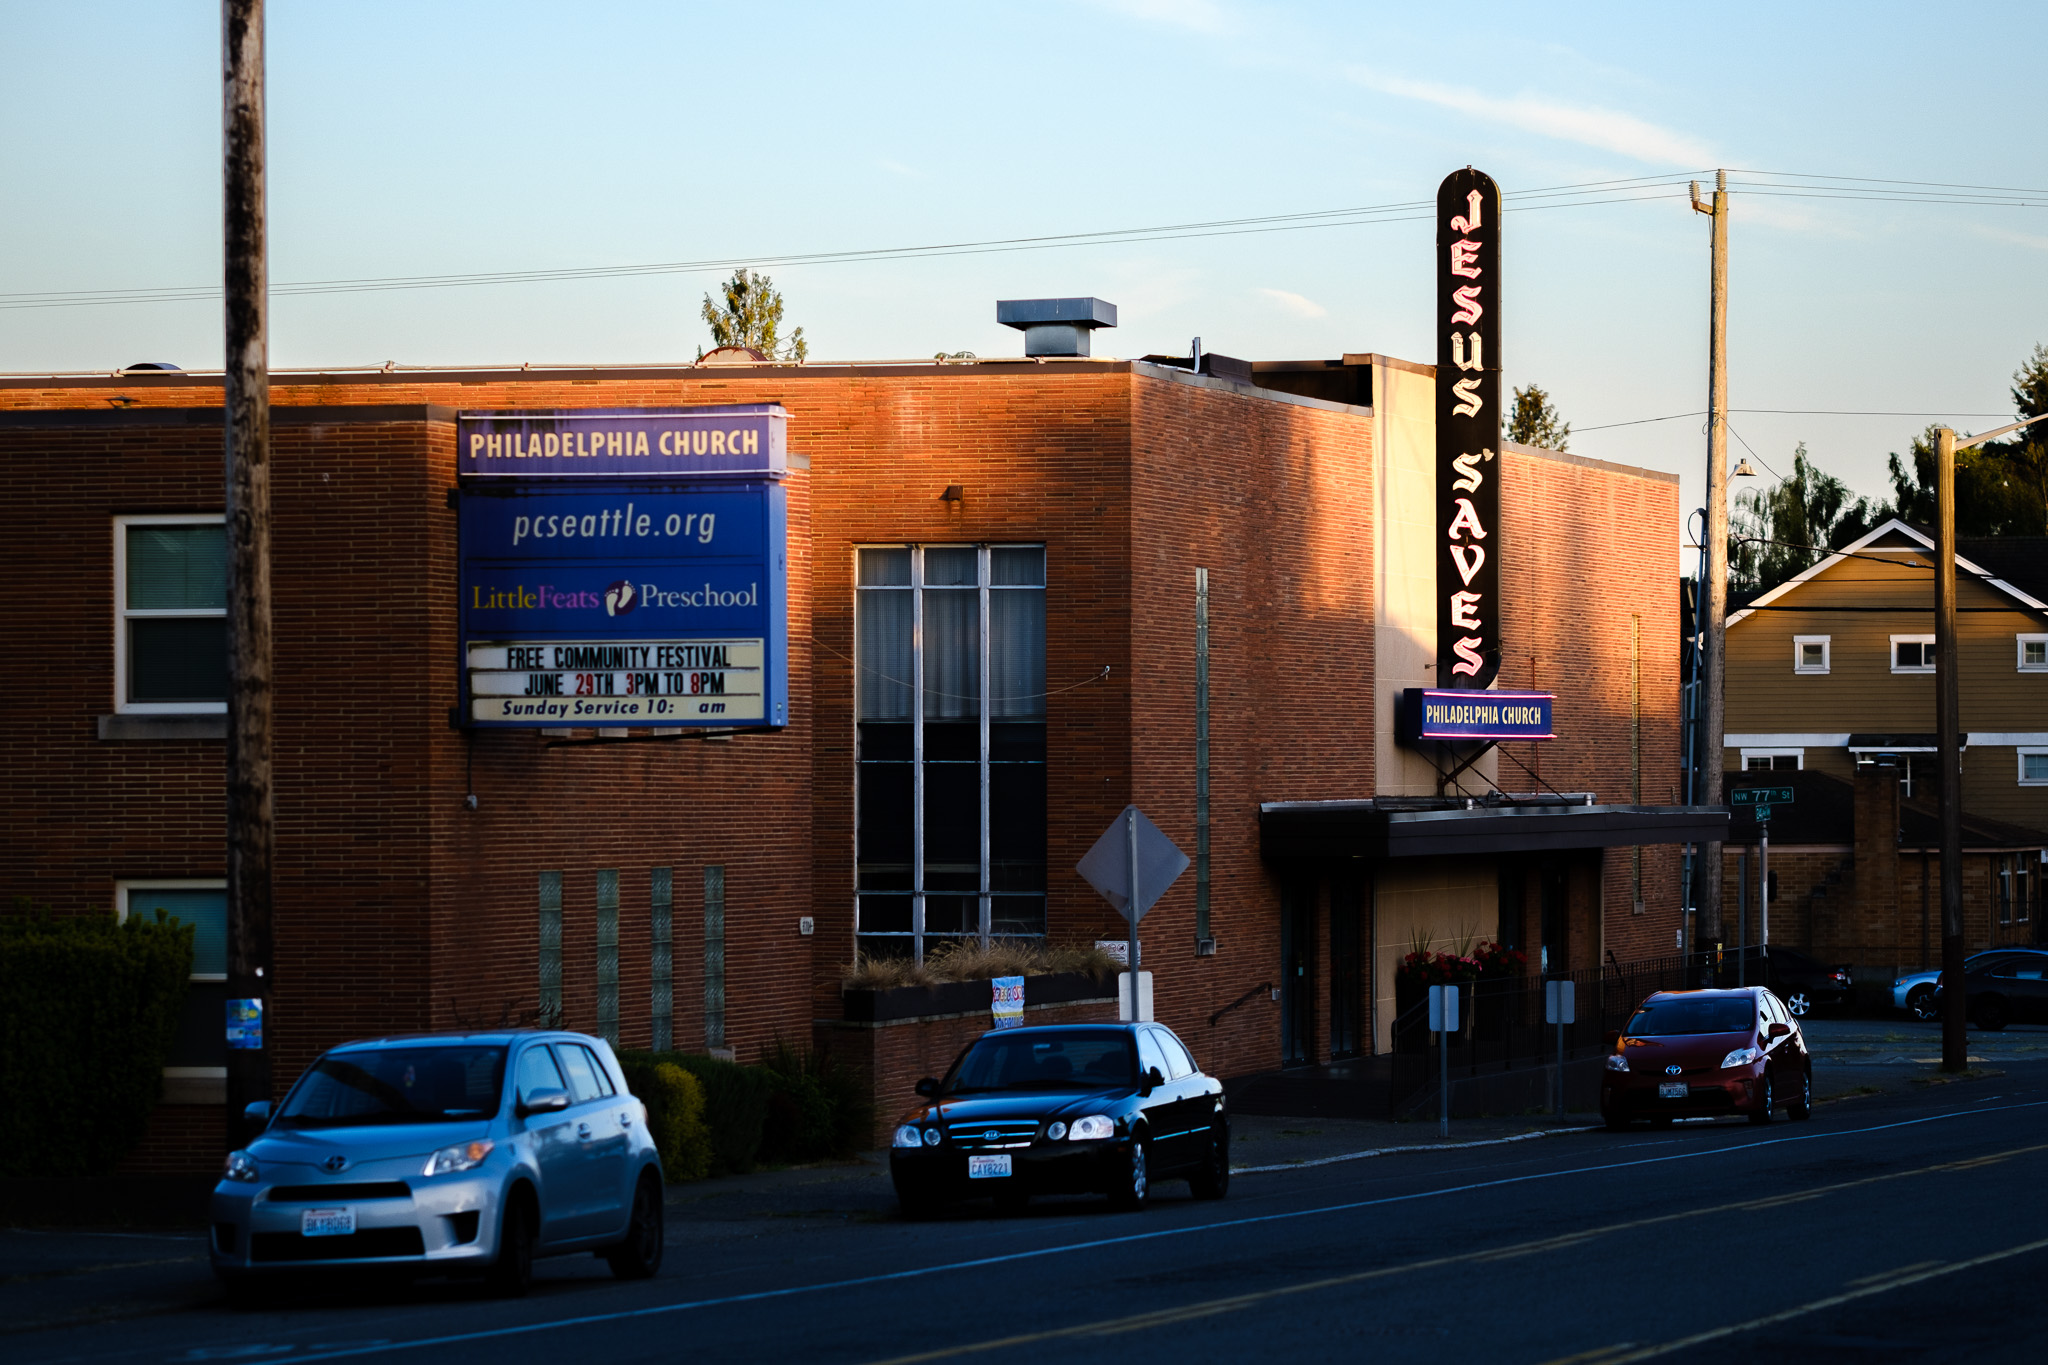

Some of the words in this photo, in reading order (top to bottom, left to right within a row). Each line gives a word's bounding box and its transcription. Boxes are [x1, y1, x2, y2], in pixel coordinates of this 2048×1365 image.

[1450, 189, 1484, 418] JESUS
[470, 430, 650, 458] PHILADELPHIA
[658, 429, 760, 455] CHURCH
[513, 502, 716, 546] pcseattle.org
[472, 585, 601, 610] LittleFeats
[640, 582, 759, 609] Preschool
[507, 648, 545, 669] FREE
[554, 647, 650, 669] COMMUNITY
[656, 646, 731, 668] FESTIVAL
[525, 673, 564, 696] JUNE
[575, 673, 614, 695] 29TH
[626, 673, 659, 695] 3PM
[663, 673, 684, 695] TO
[690, 673, 725, 695] 8PM
[502, 699, 569, 718] Sunday
[573, 699, 639, 715] Service
[646, 698, 675, 714] 10:
[698, 702, 726, 714] am
[1426, 705, 1499, 724] PHILADELPHIA
[1502, 707, 1541, 725] CHURCH
[1734, 792, 1748, 801] NW
[1781, 790, 1790, 799] St
